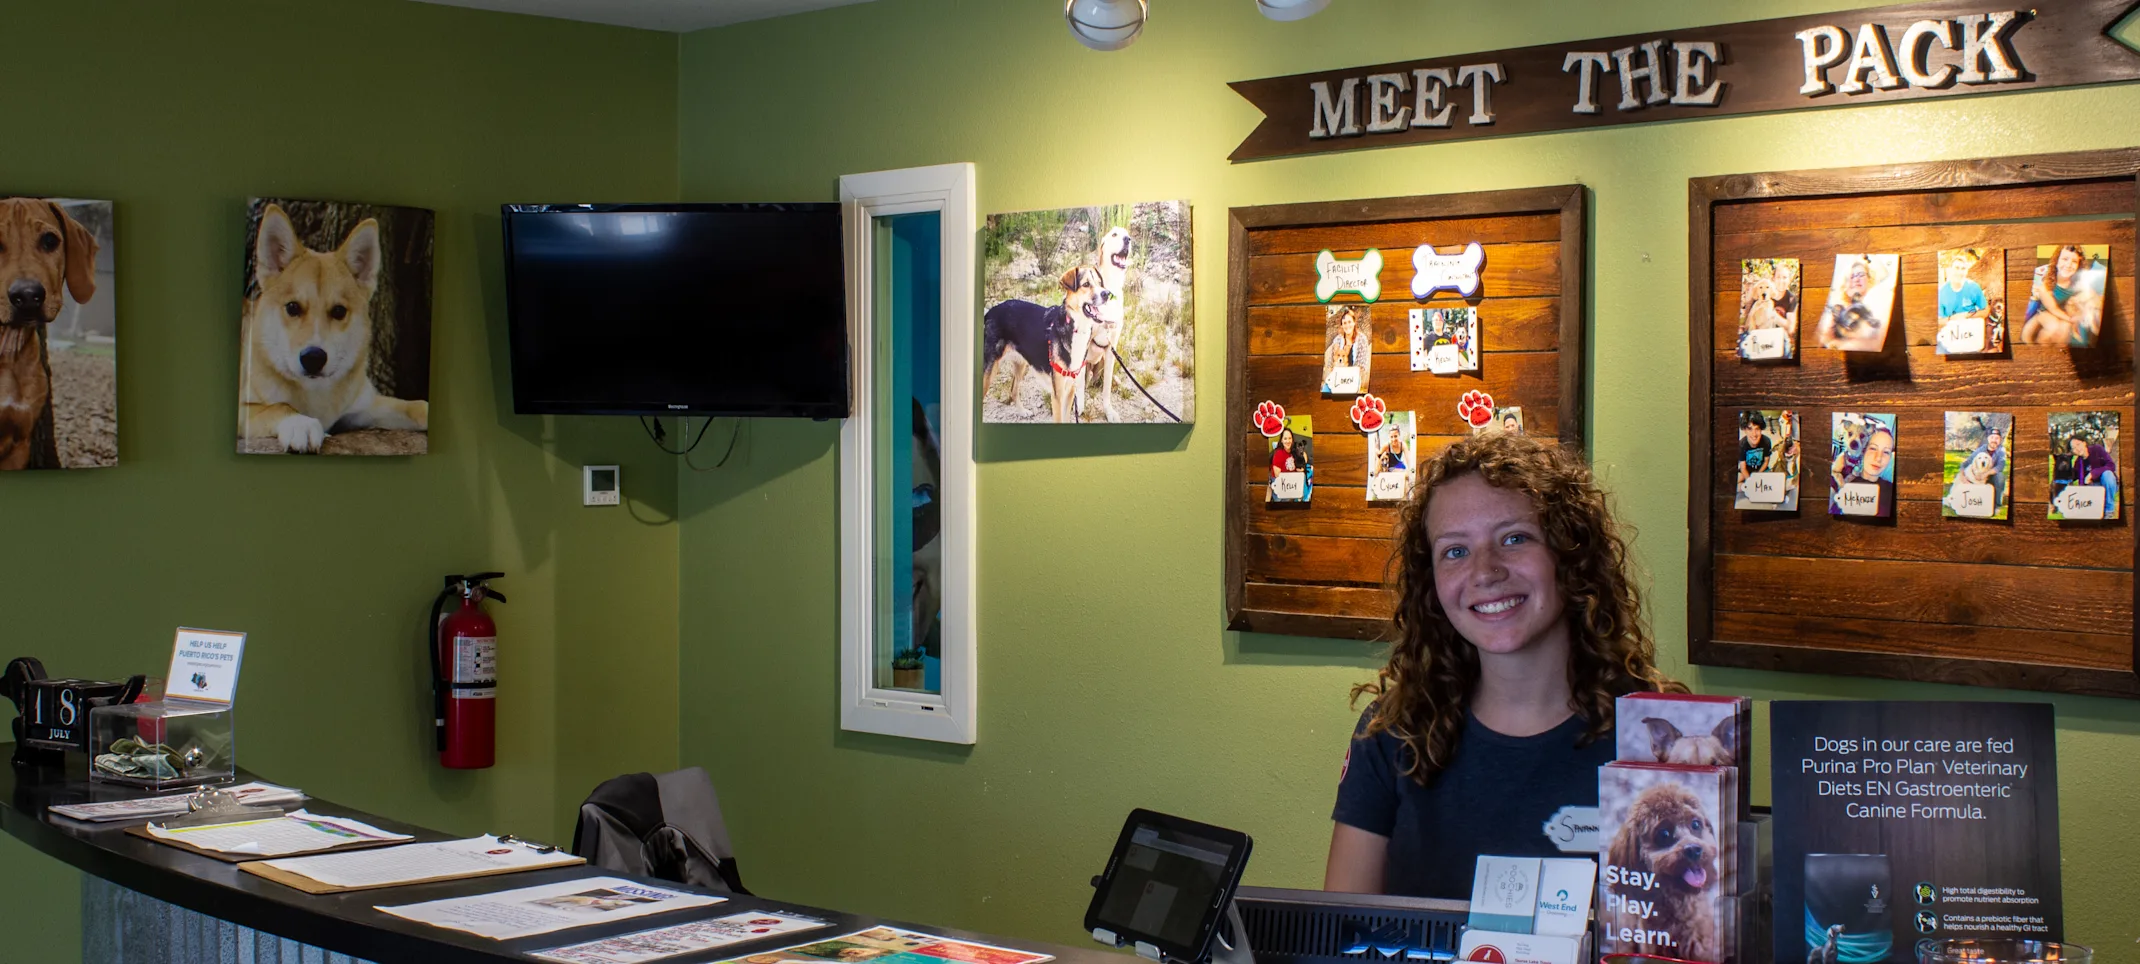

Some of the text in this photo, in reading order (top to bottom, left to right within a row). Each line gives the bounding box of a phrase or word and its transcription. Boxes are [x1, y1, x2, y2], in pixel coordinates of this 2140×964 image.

[1309, 10, 2030, 139] MEET THE PACK
[1326, 261, 1360, 279] FACILITY
[1335, 275, 1368, 289] DIRECTOR
[190, 640, 228, 650] HELP US HELP
[179, 650, 234, 661] PUERTO RICO'S PETS
[48, 728, 71, 740] JULY
[1814, 736, 2014, 755] Dogs in our care are fed
[1863, 759, 1892, 774] Pro
[1942, 760, 2028, 779] Veterinary
[1818, 781, 1862, 796] Diets
[1866, 781, 1891, 796] EN
[1846, 803, 1987, 820] Canine Formula.
[1606, 865, 1660, 891] Stay.
[1505, 864, 1518, 909] POOCHIES
[1942, 886, 1959, 895] High
[1960, 887, 1976, 895] total
[1977, 888, 2016, 896] digestibility
[1540, 900, 1577, 912] West End
[1606, 893, 1658, 919] Play.
[1942, 895, 1973, 903] promote
[2002, 896, 2040, 904] absorption
[1943, 914, 1974, 922] Contains
[1981, 915, 2012, 923] prebiotic
[1606, 922, 1677, 947] Learn.
[1943, 923, 1963, 931] helps
[1964, 923, 1989, 931] nourish
[1996, 924, 2021, 932] healthy
[1947, 946, 1984, 955] Great taste
